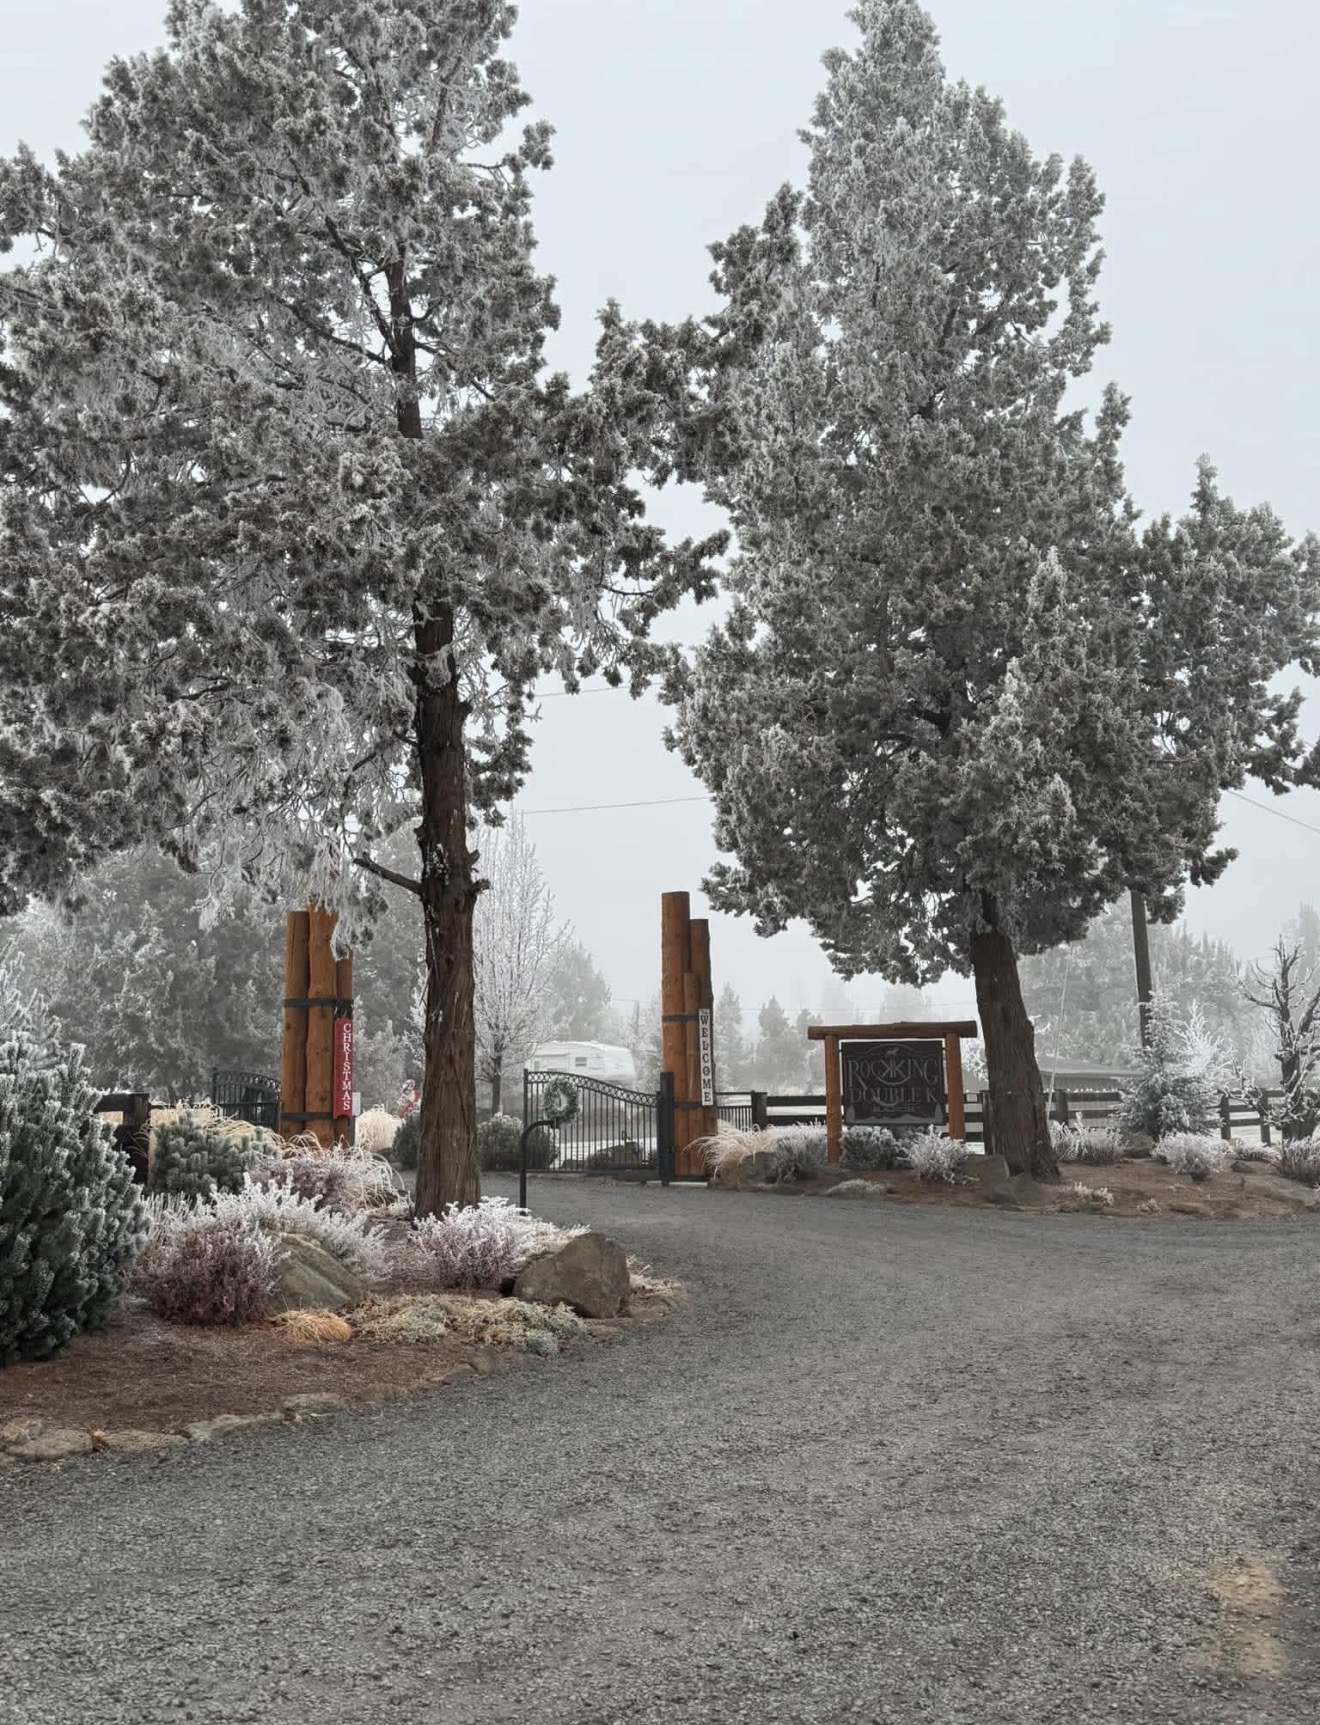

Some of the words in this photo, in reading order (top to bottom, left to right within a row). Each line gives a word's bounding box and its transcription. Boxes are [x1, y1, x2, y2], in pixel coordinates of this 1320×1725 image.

[342, 1023, 352, 1111] CHRISTMAS
[700, 1015, 712, 1103] WELCOME
[926, 1087, 938, 1103] K
